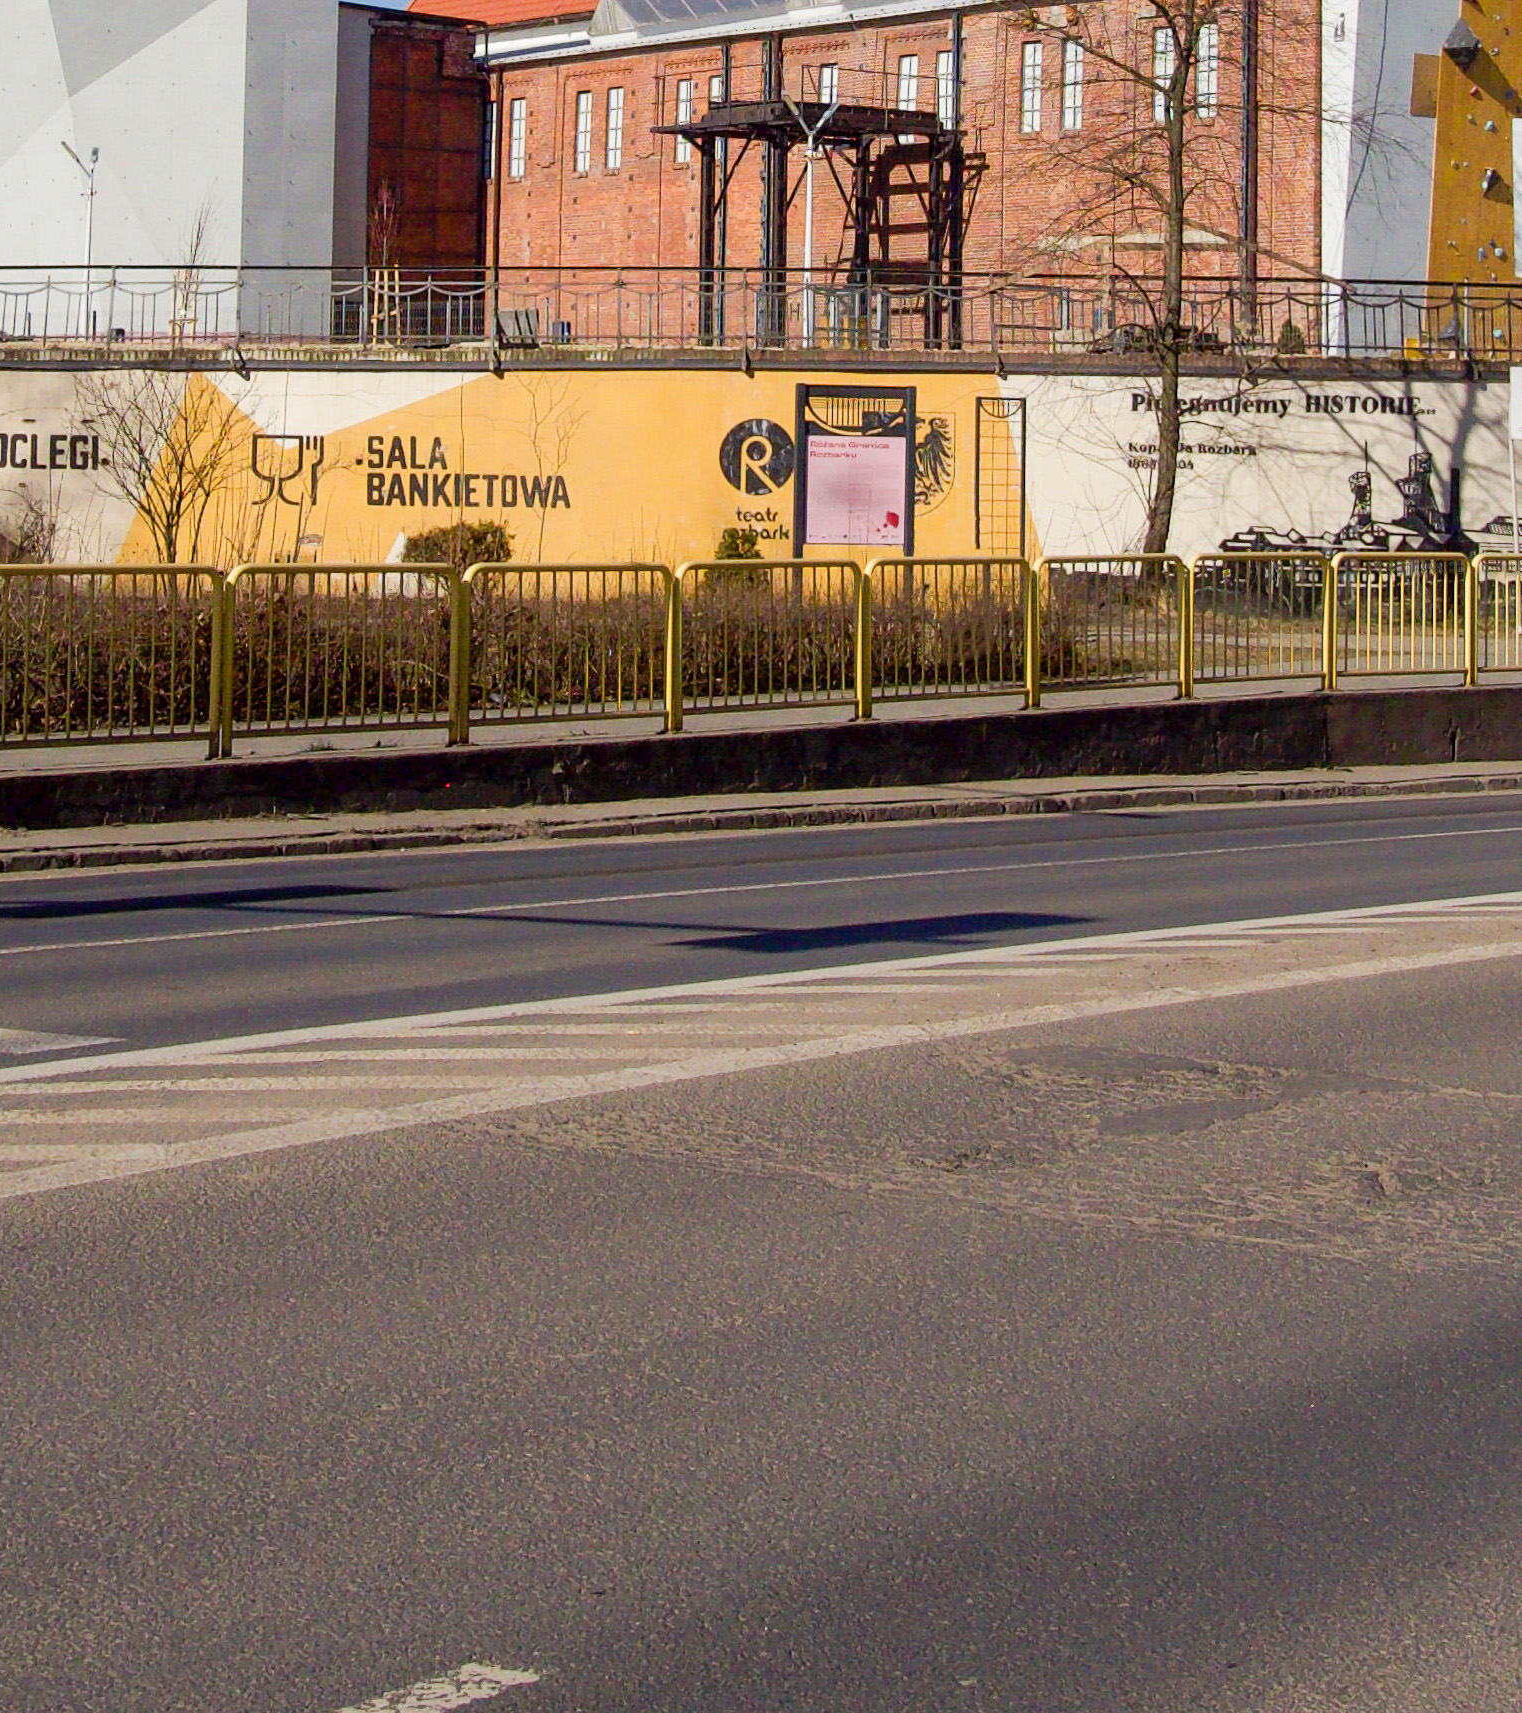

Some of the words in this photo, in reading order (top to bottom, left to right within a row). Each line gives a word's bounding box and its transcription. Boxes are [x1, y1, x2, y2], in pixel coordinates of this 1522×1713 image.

[368, 436, 447, 469] SALA
[367, 473, 571, 509] BANKIETOWA
[736, 507, 778, 522] teatr
